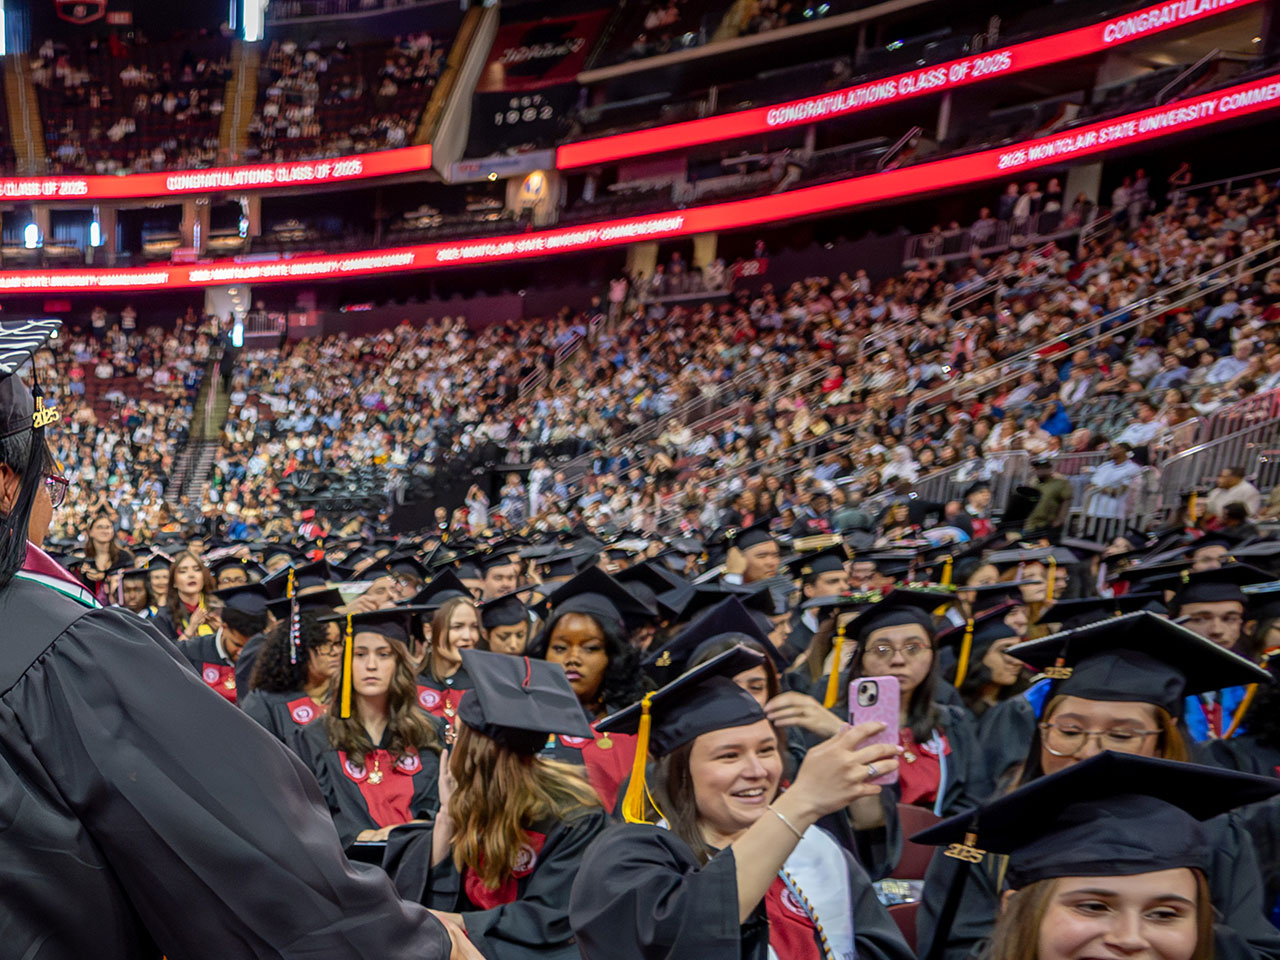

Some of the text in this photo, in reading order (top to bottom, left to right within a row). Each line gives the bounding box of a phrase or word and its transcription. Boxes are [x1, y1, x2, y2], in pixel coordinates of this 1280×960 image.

[1103, 0, 1235, 43] CONGRATULA
[767, 51, 1012, 125] CONGRATULATIONS CLASS OF 2025
[998, 153, 1028, 169] 2025
[1028, 132, 1097, 161] MONTCLAIR
[1098, 120, 1138, 144] STATE
[1138, 99, 1218, 132] UNIVERSITY
[166, 160, 362, 190] CONGRATULATIONS CLASS OF 2025
[33, 406, 60, 428] 2025
[944, 843, 987, 864] 2025
